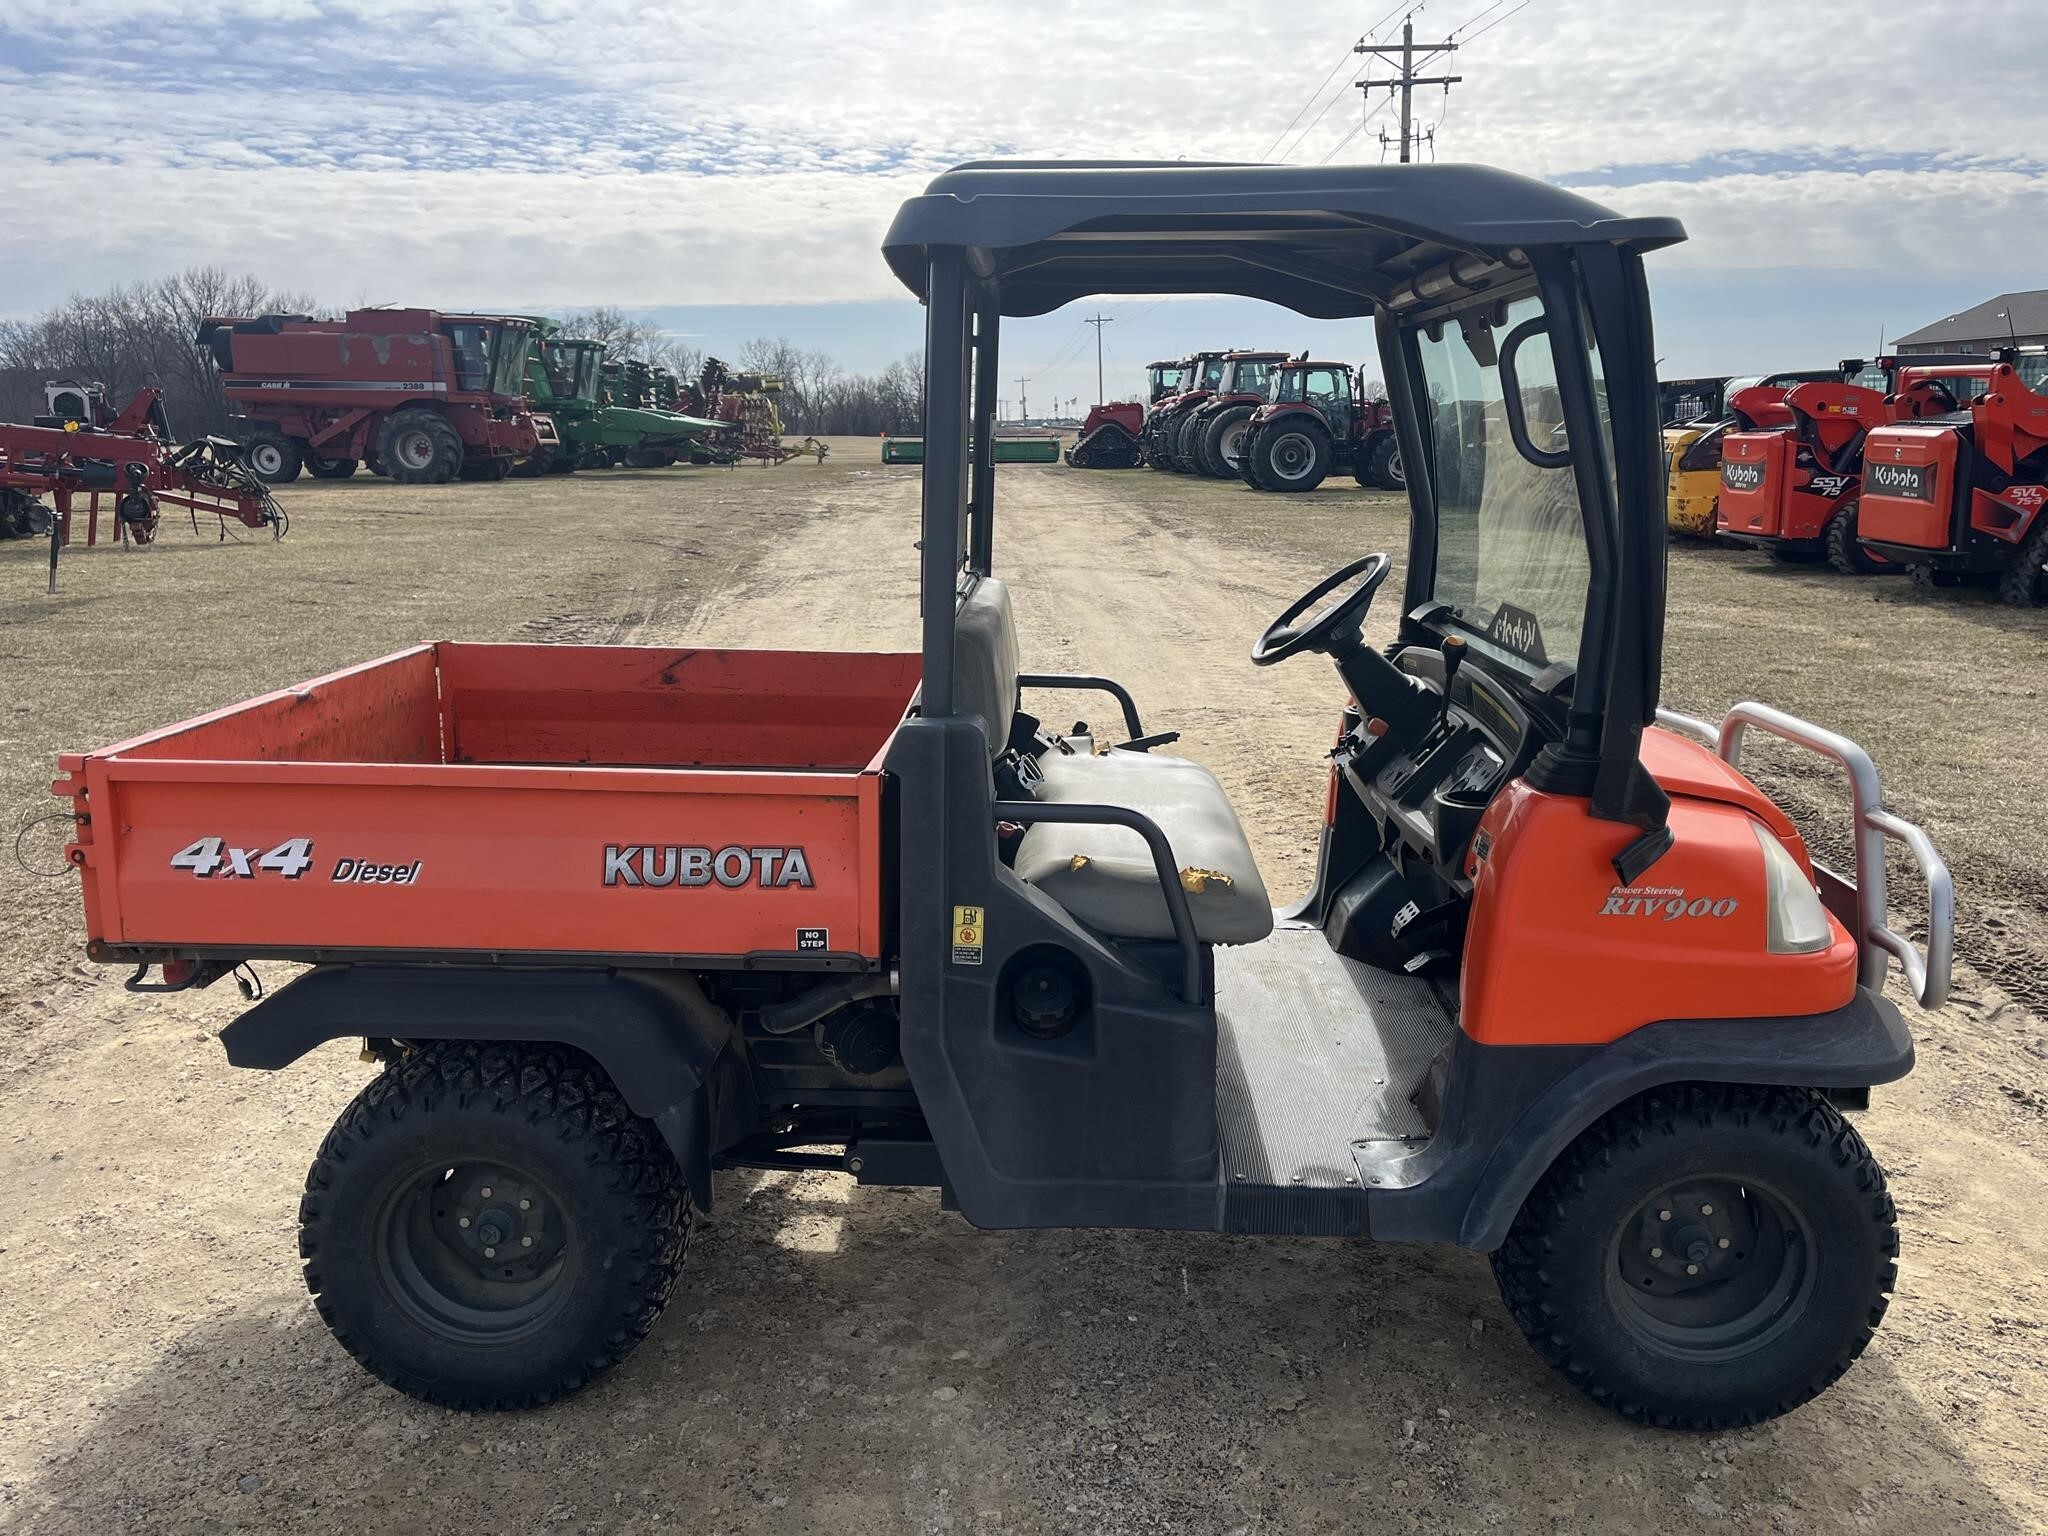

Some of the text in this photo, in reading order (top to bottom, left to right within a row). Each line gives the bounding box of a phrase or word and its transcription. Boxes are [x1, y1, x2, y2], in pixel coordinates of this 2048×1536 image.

[1726, 464, 1758, 483] Kubota
[1875, 466, 1919, 488] Kubota
[1811, 476, 1850, 488] SSV
[1821, 487, 1841, 496] 75
[2010, 487, 2041, 497] SVL
[2016, 497, 2042, 505] 75-3
[170, 836, 423, 885] 4x4 Diesel
[603, 845, 814, 888] KUBOTA
[1611, 886, 1685, 897] Power Steering
[1599, 896, 1739, 922] RTV900
[805, 931, 819, 939] NO
[800, 940, 824, 948] STEP
